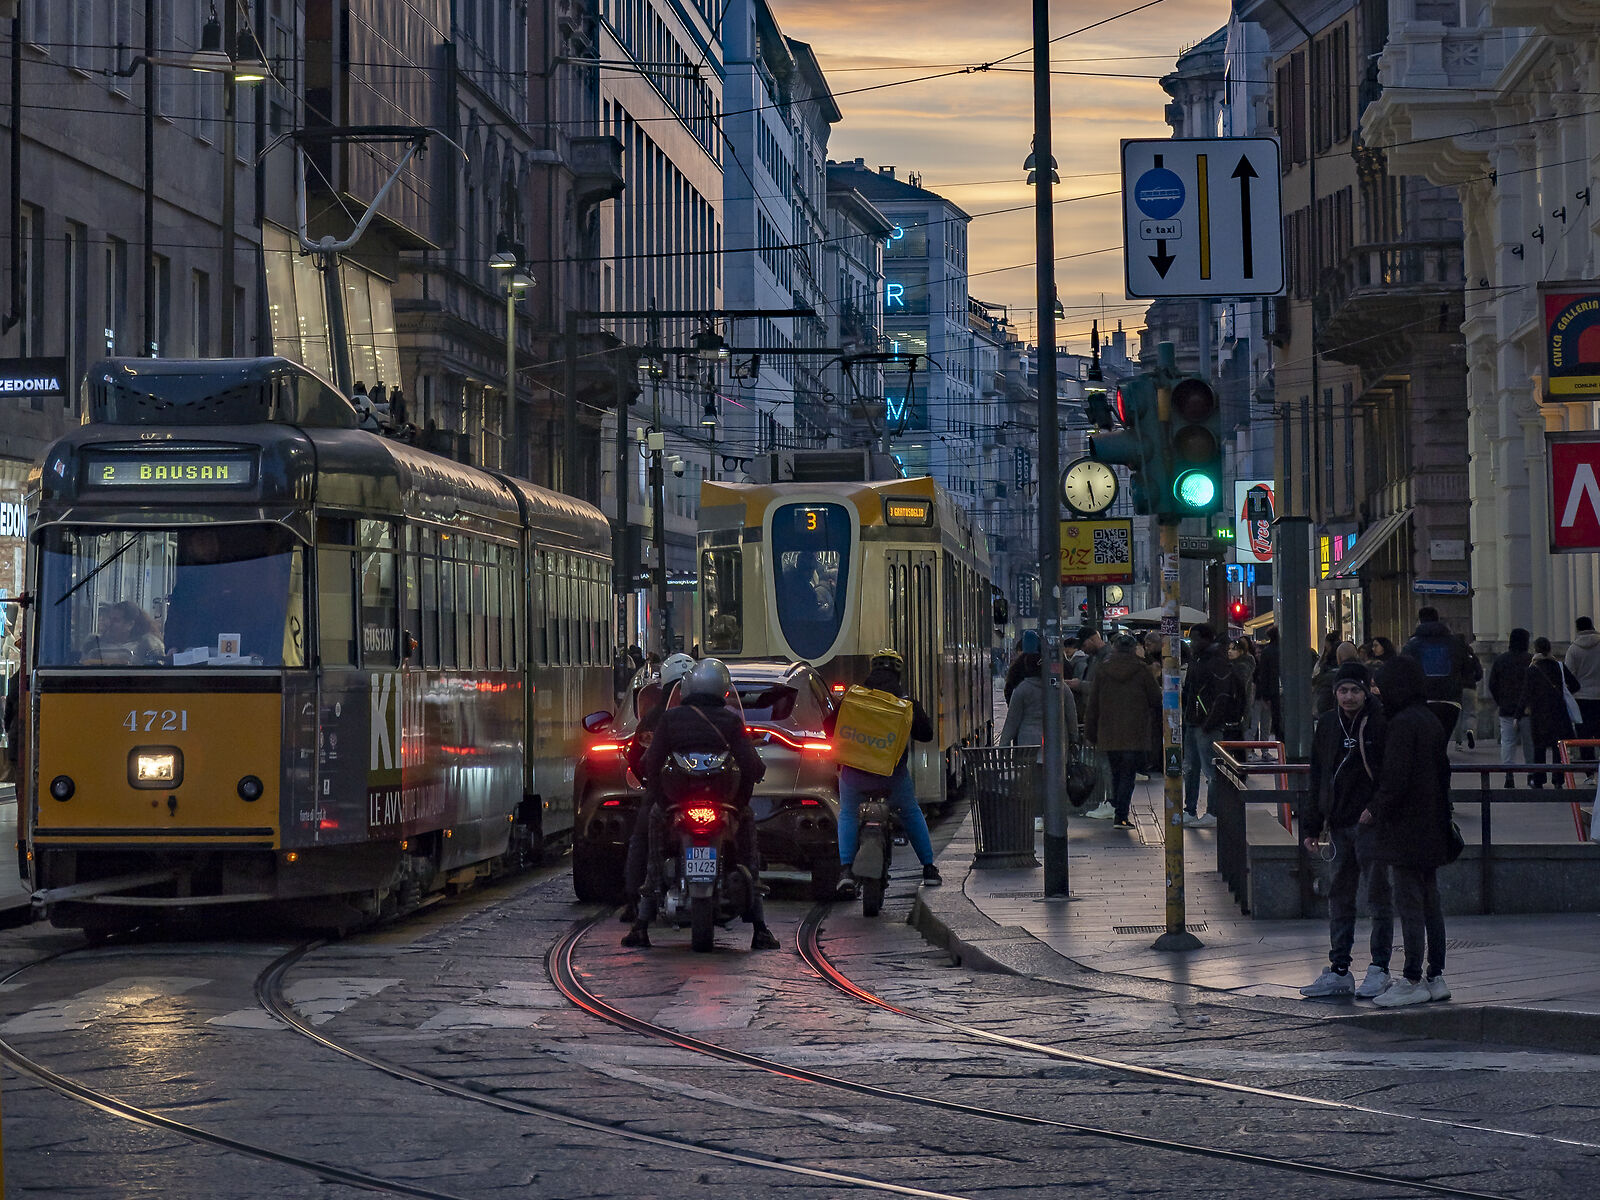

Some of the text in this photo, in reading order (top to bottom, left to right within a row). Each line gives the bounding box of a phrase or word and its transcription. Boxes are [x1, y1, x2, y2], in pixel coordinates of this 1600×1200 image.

[1156, 225, 1176, 234] taxi
[1553, 299, 1599, 367] CIVICA GALLERIA
[103, 465, 228, 480] 2 BAUSAN
[806, 511, 817, 530] 3
[1104, 607, 1125, 616] KFC
[225, 640, 233, 653] 8
[364, 628, 395, 651] GUSTAV
[122, 709, 188, 732] 4721
[839, 725, 889, 750] Glovo
[694, 849, 705, 859] DY
[687, 861, 716, 873] 91423
